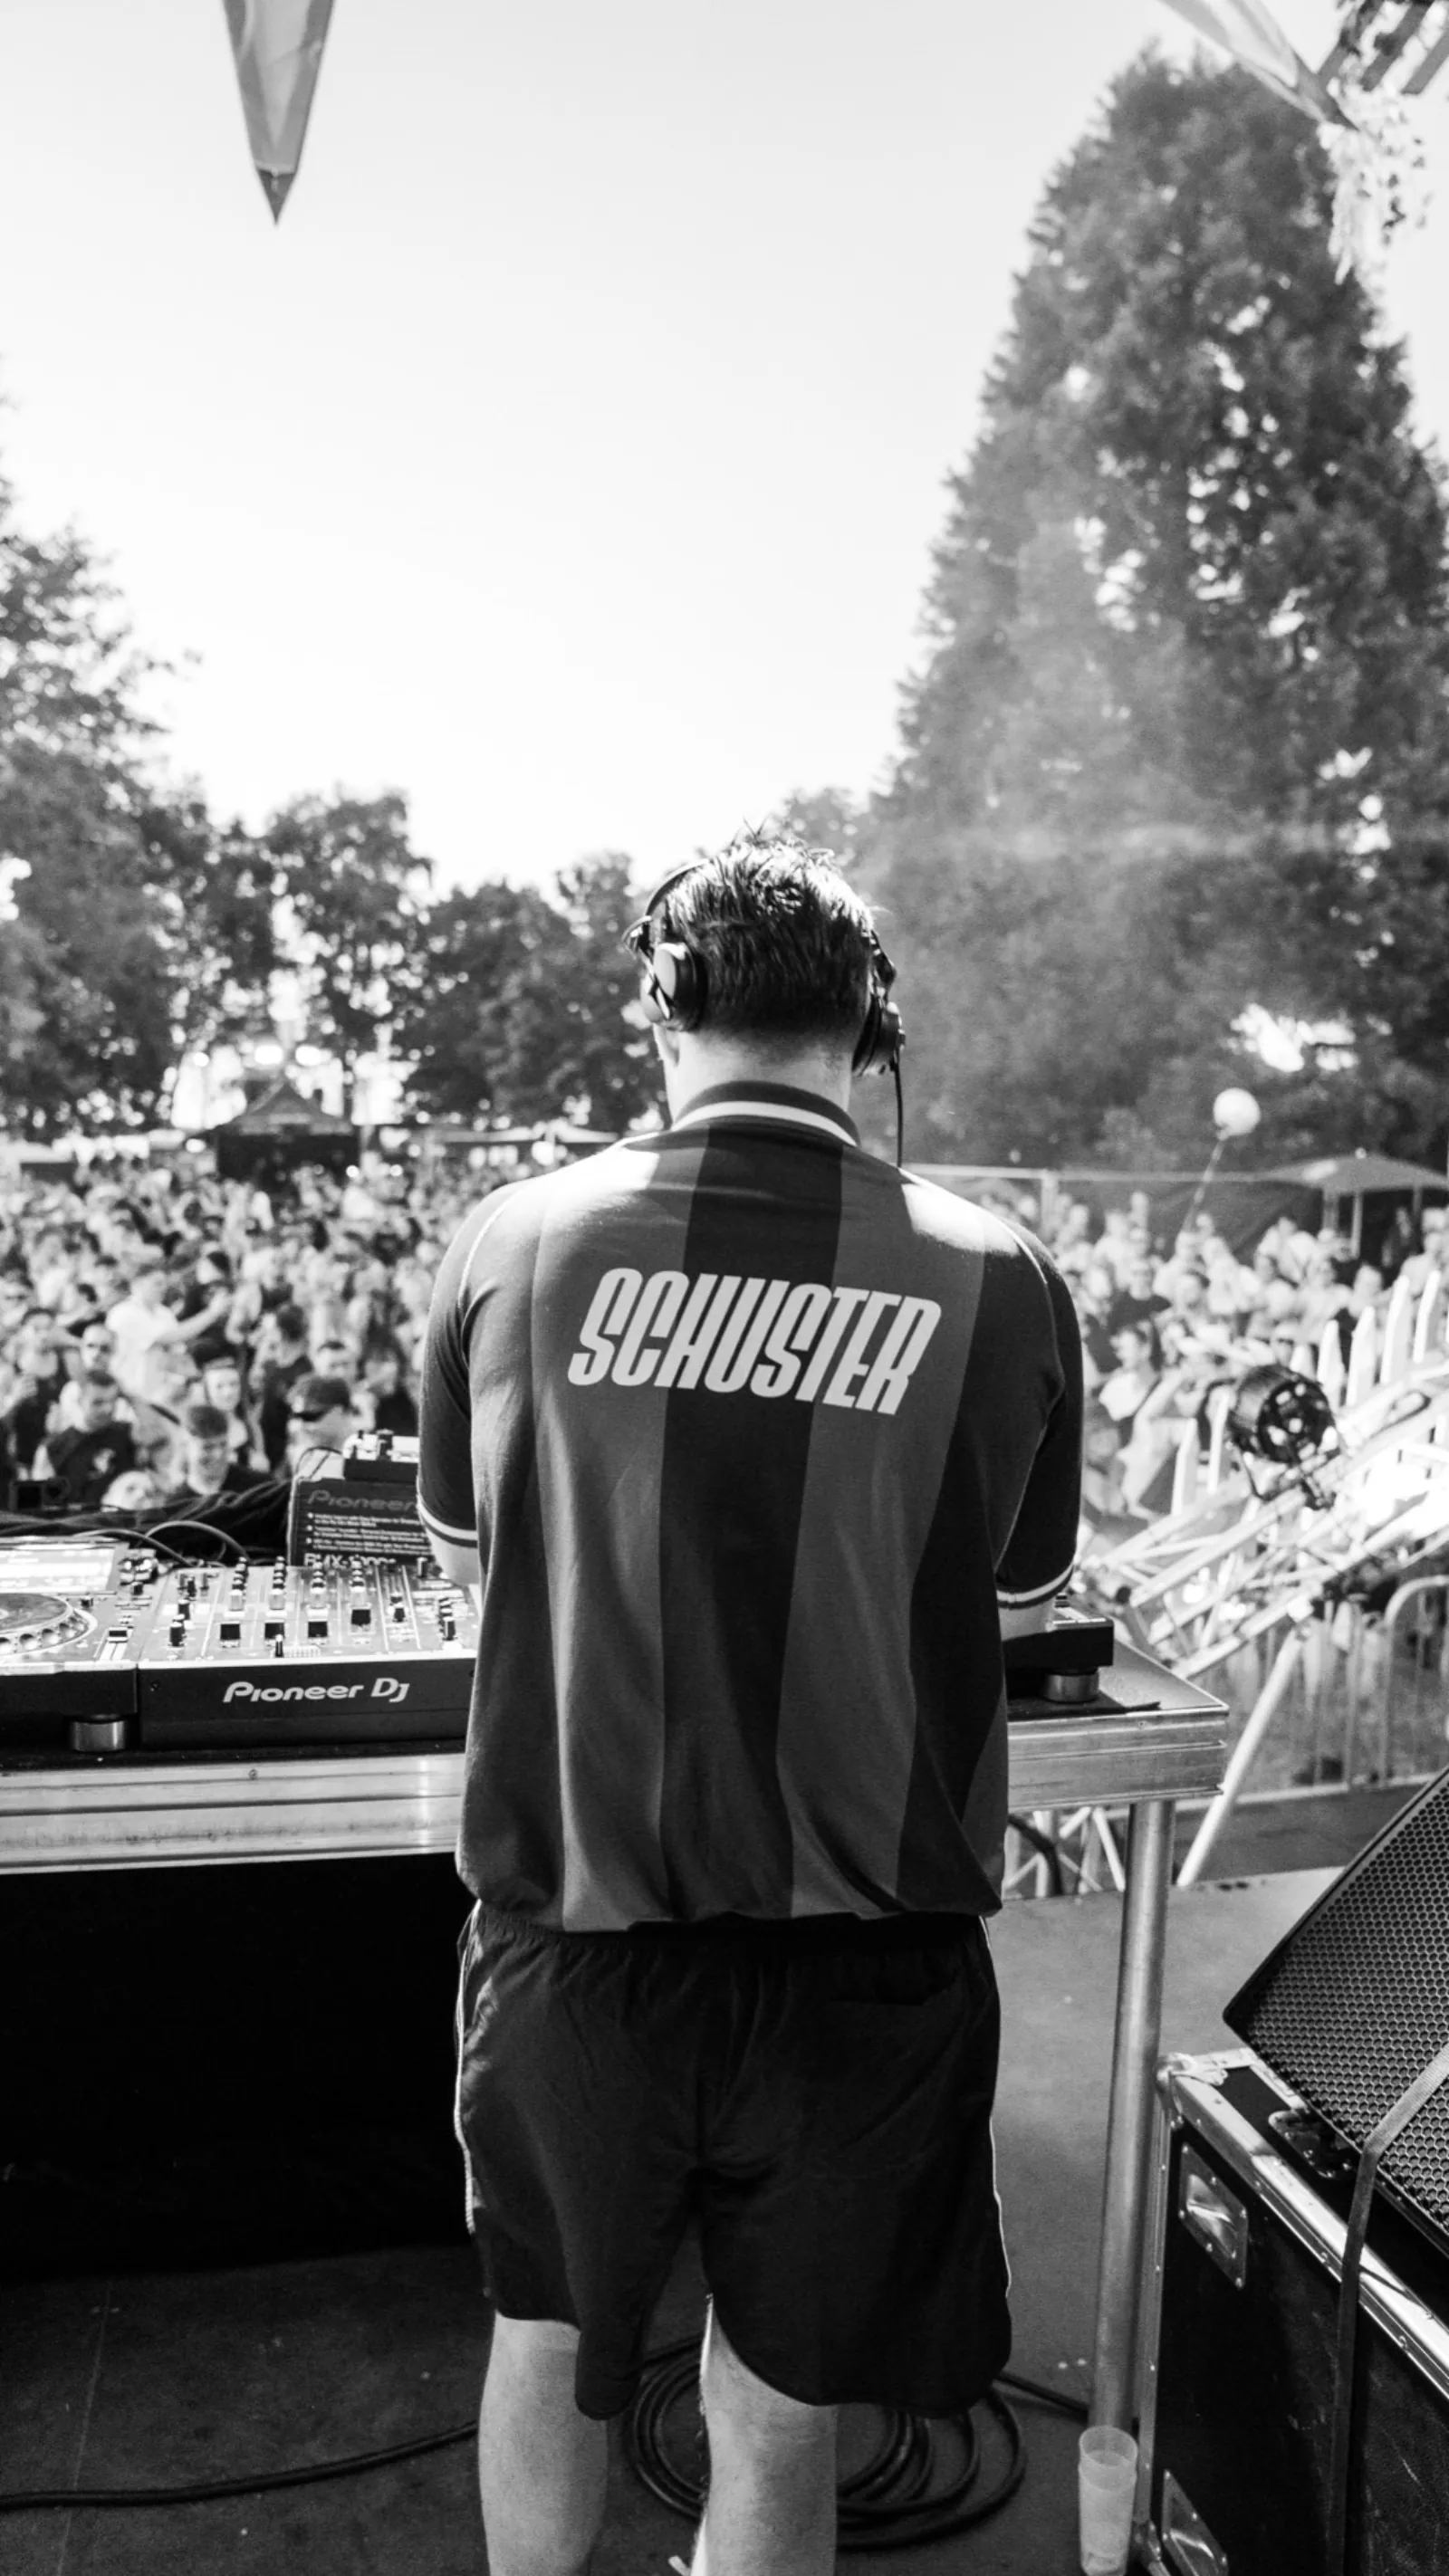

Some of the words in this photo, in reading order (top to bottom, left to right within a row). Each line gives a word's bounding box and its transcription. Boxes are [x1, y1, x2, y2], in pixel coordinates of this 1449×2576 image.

[567, 1268, 942, 1415] SCHUSTER
[307, 1489, 416, 1510] Pioneer
[223, 1681, 364, 1703] Pioneer
